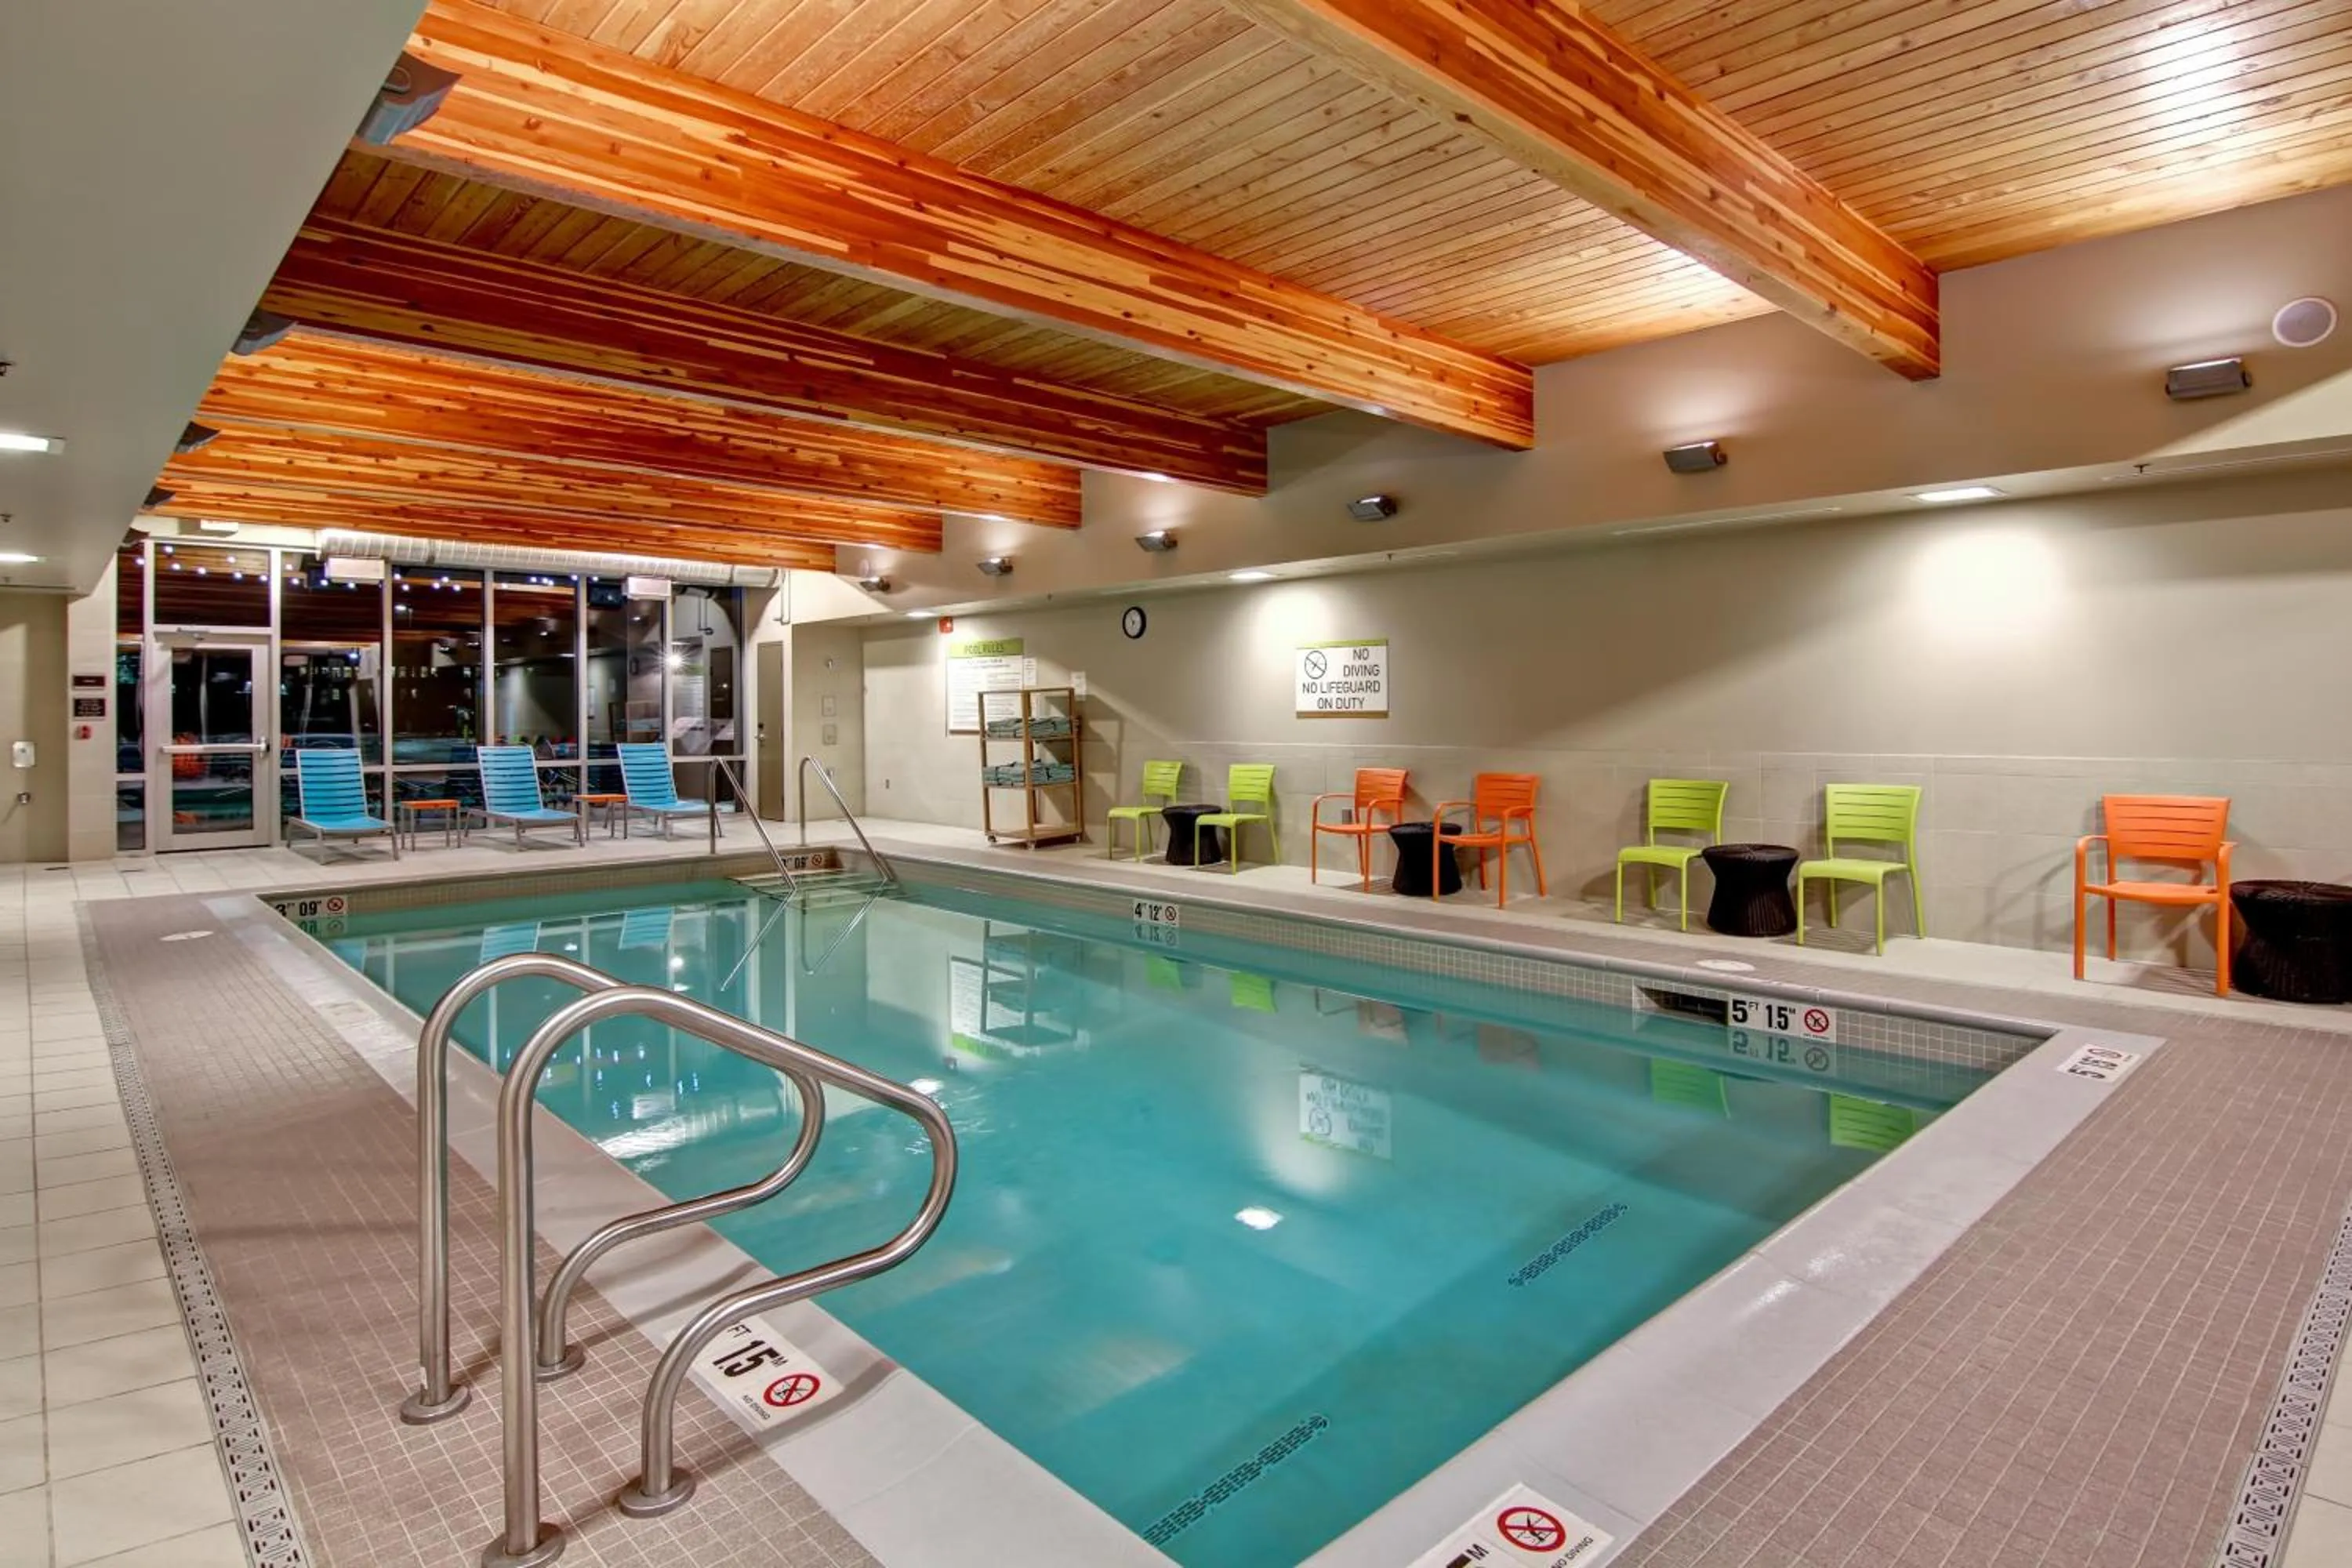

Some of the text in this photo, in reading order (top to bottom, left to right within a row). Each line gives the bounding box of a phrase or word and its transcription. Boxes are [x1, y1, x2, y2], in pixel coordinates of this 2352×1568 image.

[1352, 648, 1370, 660] NO
[1343, 664, 1380, 677] DIVING
[1302, 680, 1381, 694] NO LIFEGUARD
[1317, 697, 1365, 710] ON DUTY
[1732, 999, 1748, 1023] 5
[1465, 1543, 1490, 1561] M
